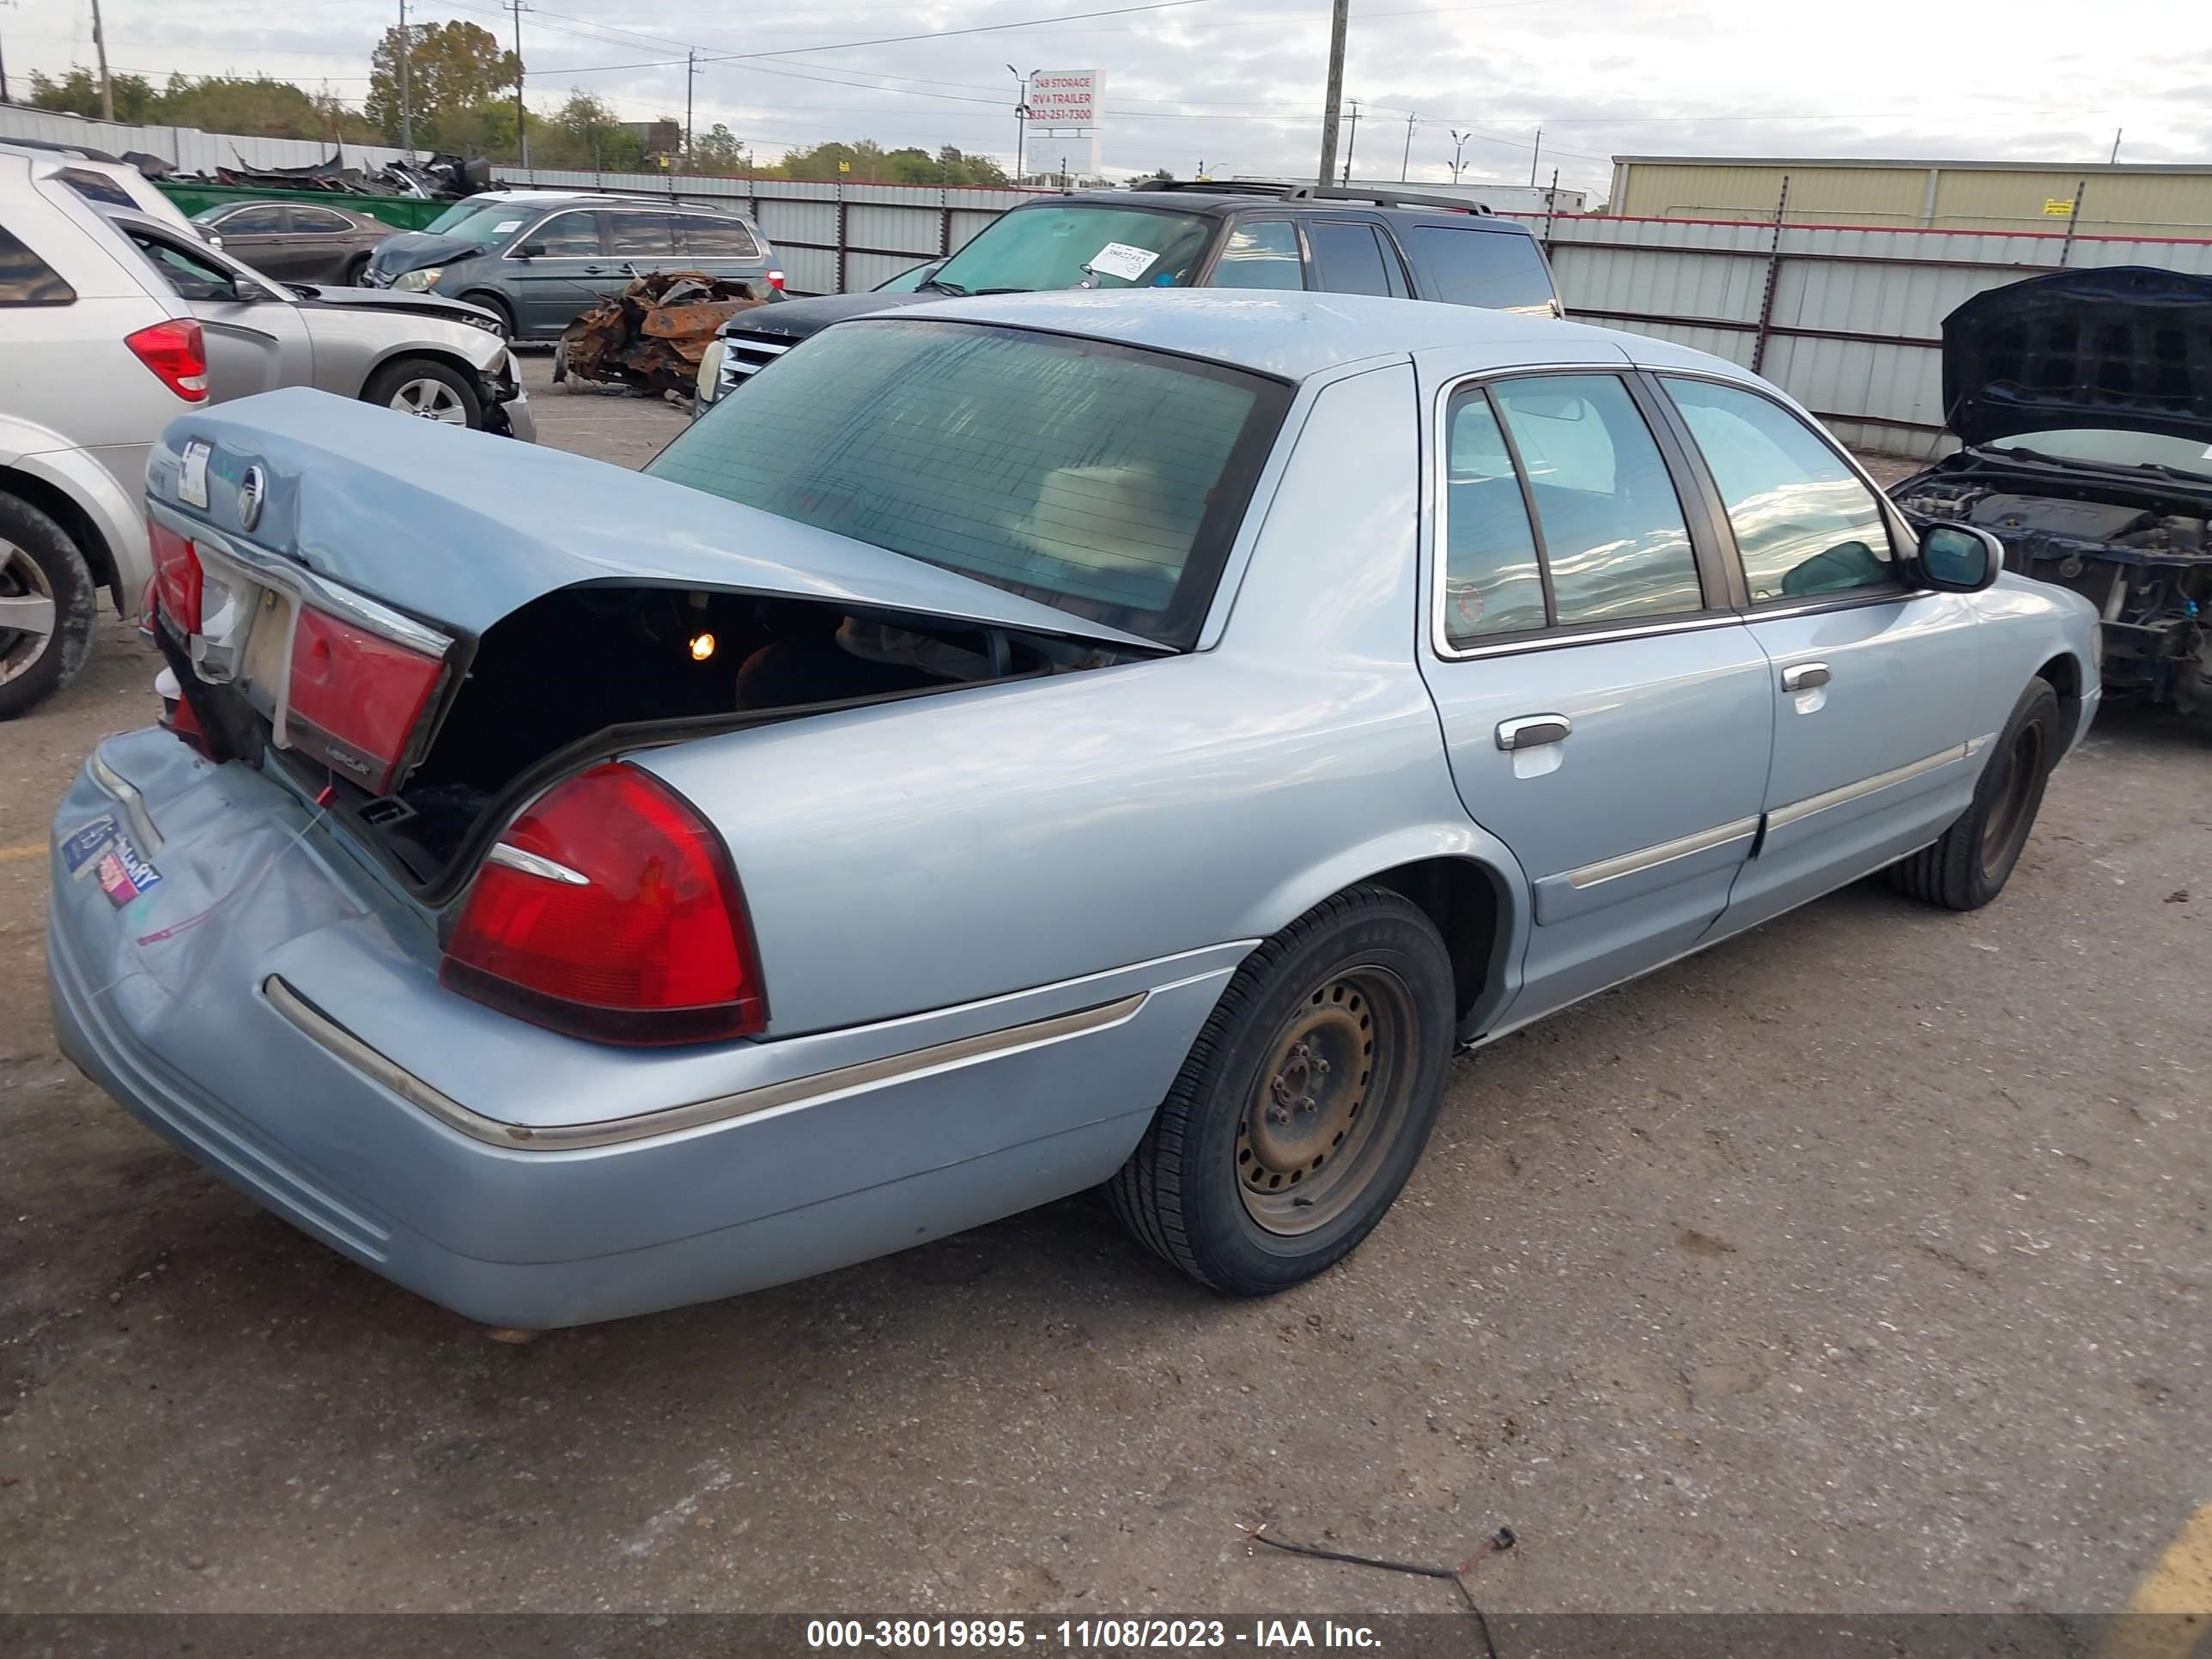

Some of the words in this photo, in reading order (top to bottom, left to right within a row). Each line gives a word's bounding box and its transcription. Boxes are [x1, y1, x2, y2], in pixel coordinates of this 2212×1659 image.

[1051, 77, 1091, 88] STORAGE
[1032, 94, 1045, 104] RV
[1052, 93, 1091, 104] TRAILER
